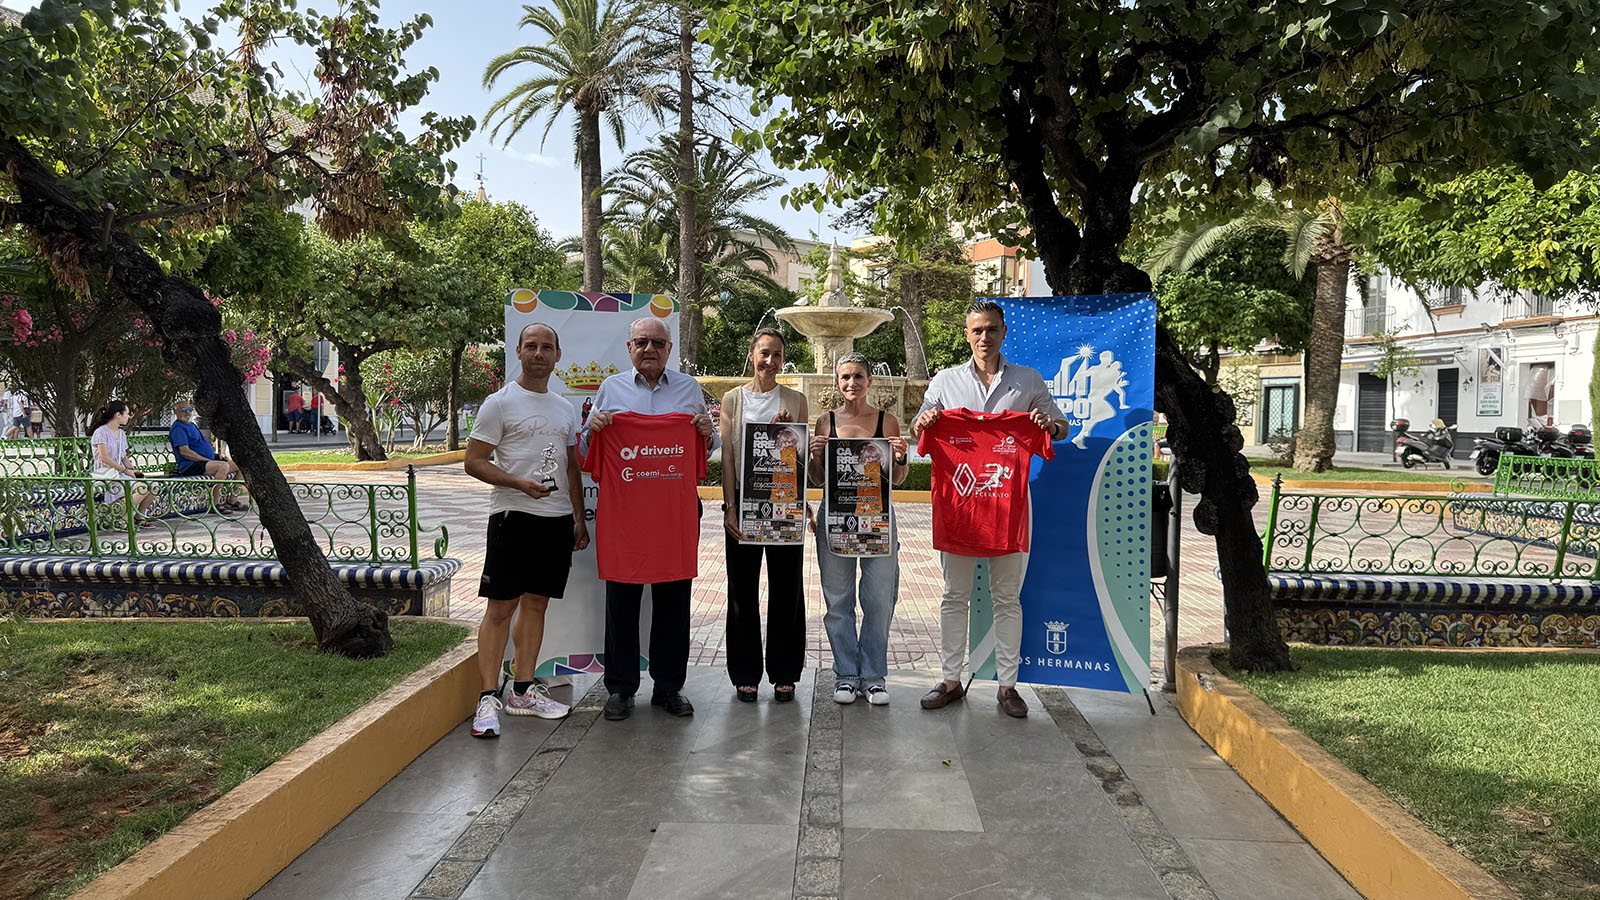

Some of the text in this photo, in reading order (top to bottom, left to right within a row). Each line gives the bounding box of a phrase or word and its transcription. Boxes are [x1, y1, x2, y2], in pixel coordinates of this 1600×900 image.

[753, 432, 769, 440] CA
[753, 440, 775, 448] RRE
[640, 444, 684, 456] driveris
[753, 449, 768, 457] RA
[836, 447, 852, 456] CA
[836, 456, 859, 464] RRE
[836, 464, 852, 472] RA
[636, 469, 660, 477] coemi
[1018, 657, 1111, 672] OS HERMANAS
